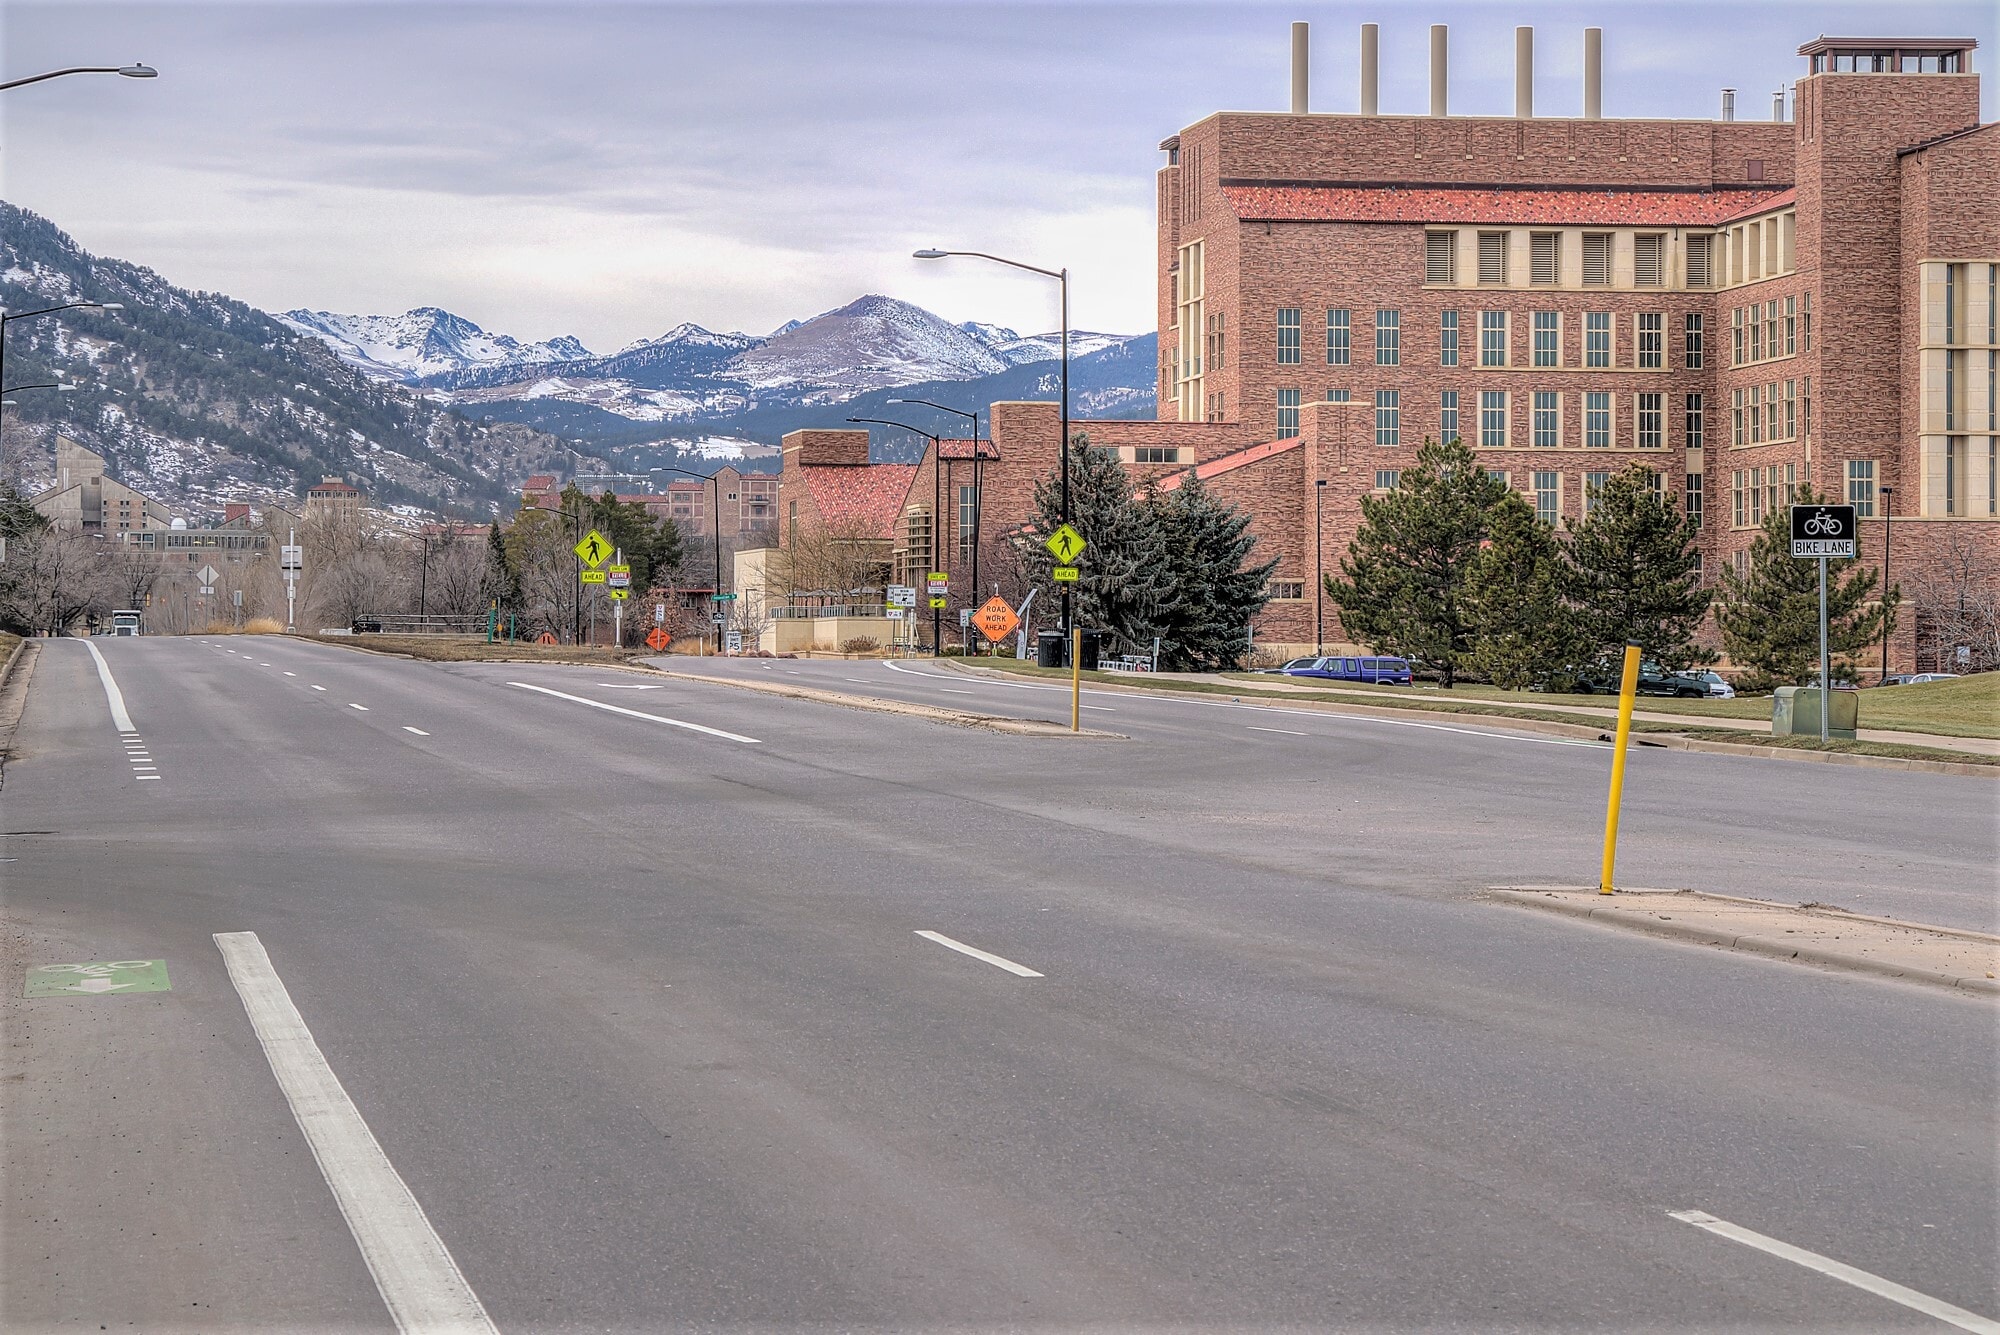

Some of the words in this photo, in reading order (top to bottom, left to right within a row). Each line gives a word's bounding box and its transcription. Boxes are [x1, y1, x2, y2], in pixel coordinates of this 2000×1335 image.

[1795, 541, 1819, 554] BIKE
[1824, 541, 1851, 554] LANE
[584, 573, 603, 581] AHEAD
[986, 605, 1007, 613] ROAD
[985, 614, 1007, 622] WORK
